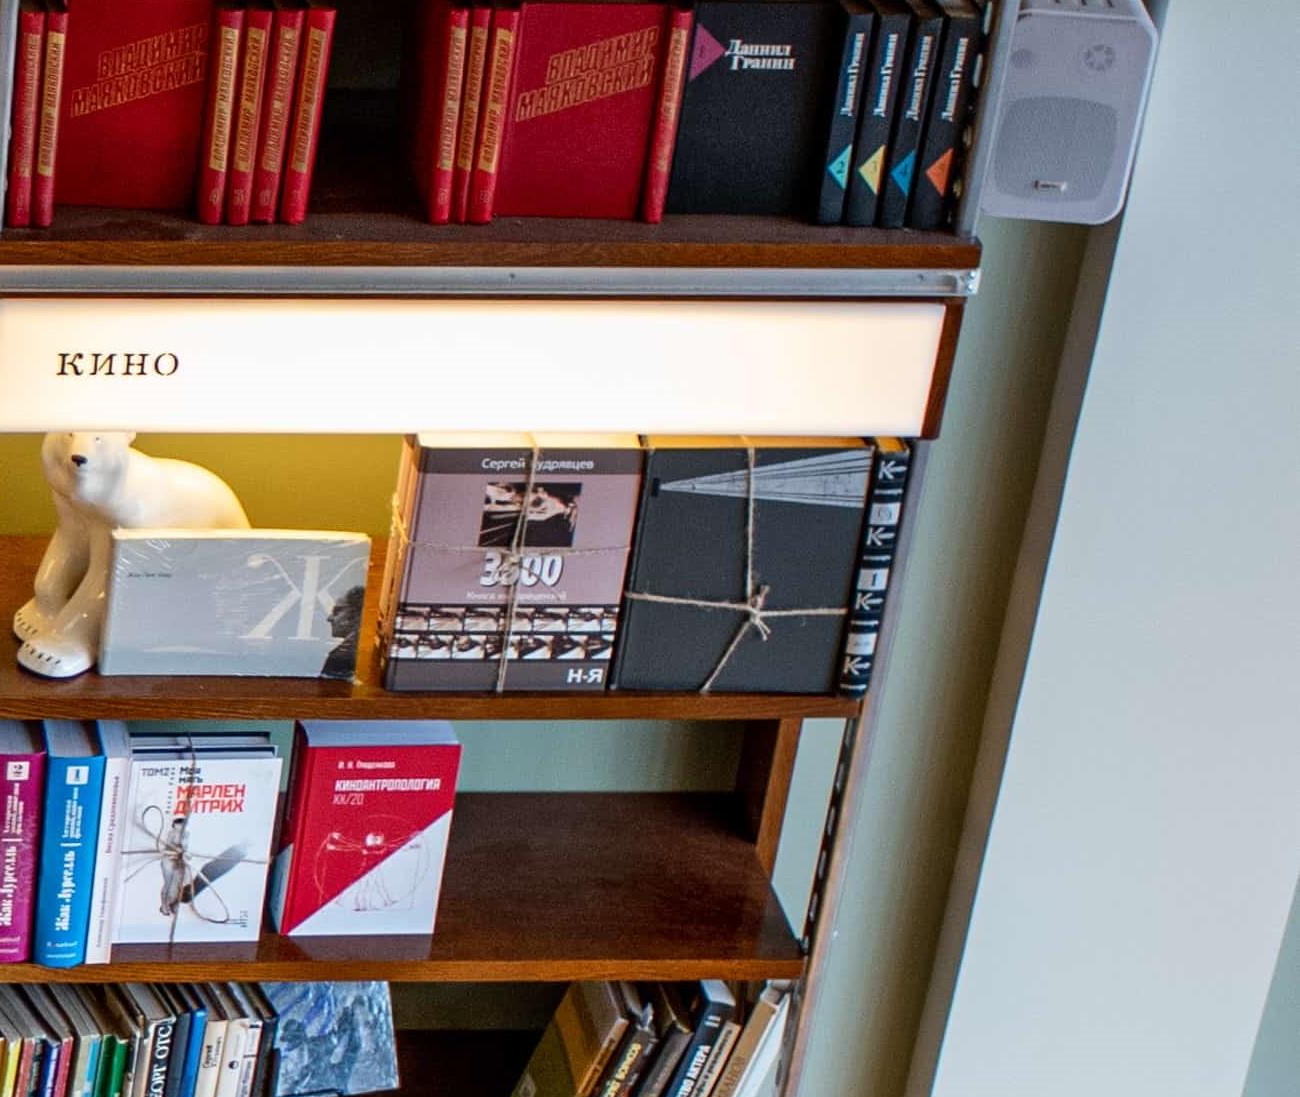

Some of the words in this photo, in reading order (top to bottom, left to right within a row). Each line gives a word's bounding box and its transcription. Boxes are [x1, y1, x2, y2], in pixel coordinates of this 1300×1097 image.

[98, 24, 207, 79] ВЛАДИМИР
[547, 26, 660, 84] ВЛАДИМИР
[726, 39, 793, 59] Даниил
[730, 54, 797, 73] Гранин
[70, 53, 207, 118] МАЯКОВСКИЙ
[516, 59, 654, 122] МАЯКОВСКИЙ
[57, 354, 180, 377] кино
[481, 458, 525, 472] Сергей
[526, 459, 594, 472] удрявцев
[566, 667, 605, 684] Н-Я
[176, 784, 246, 800] МАРЛЕН
[335, 776, 441, 792] КИНОАНТРОПОЛОГИЯ
[173, 799, 244, 816] ДИТРИХ
[54, 902, 72, 931] Жак
[153, 1023, 173, 1061] ОТС
